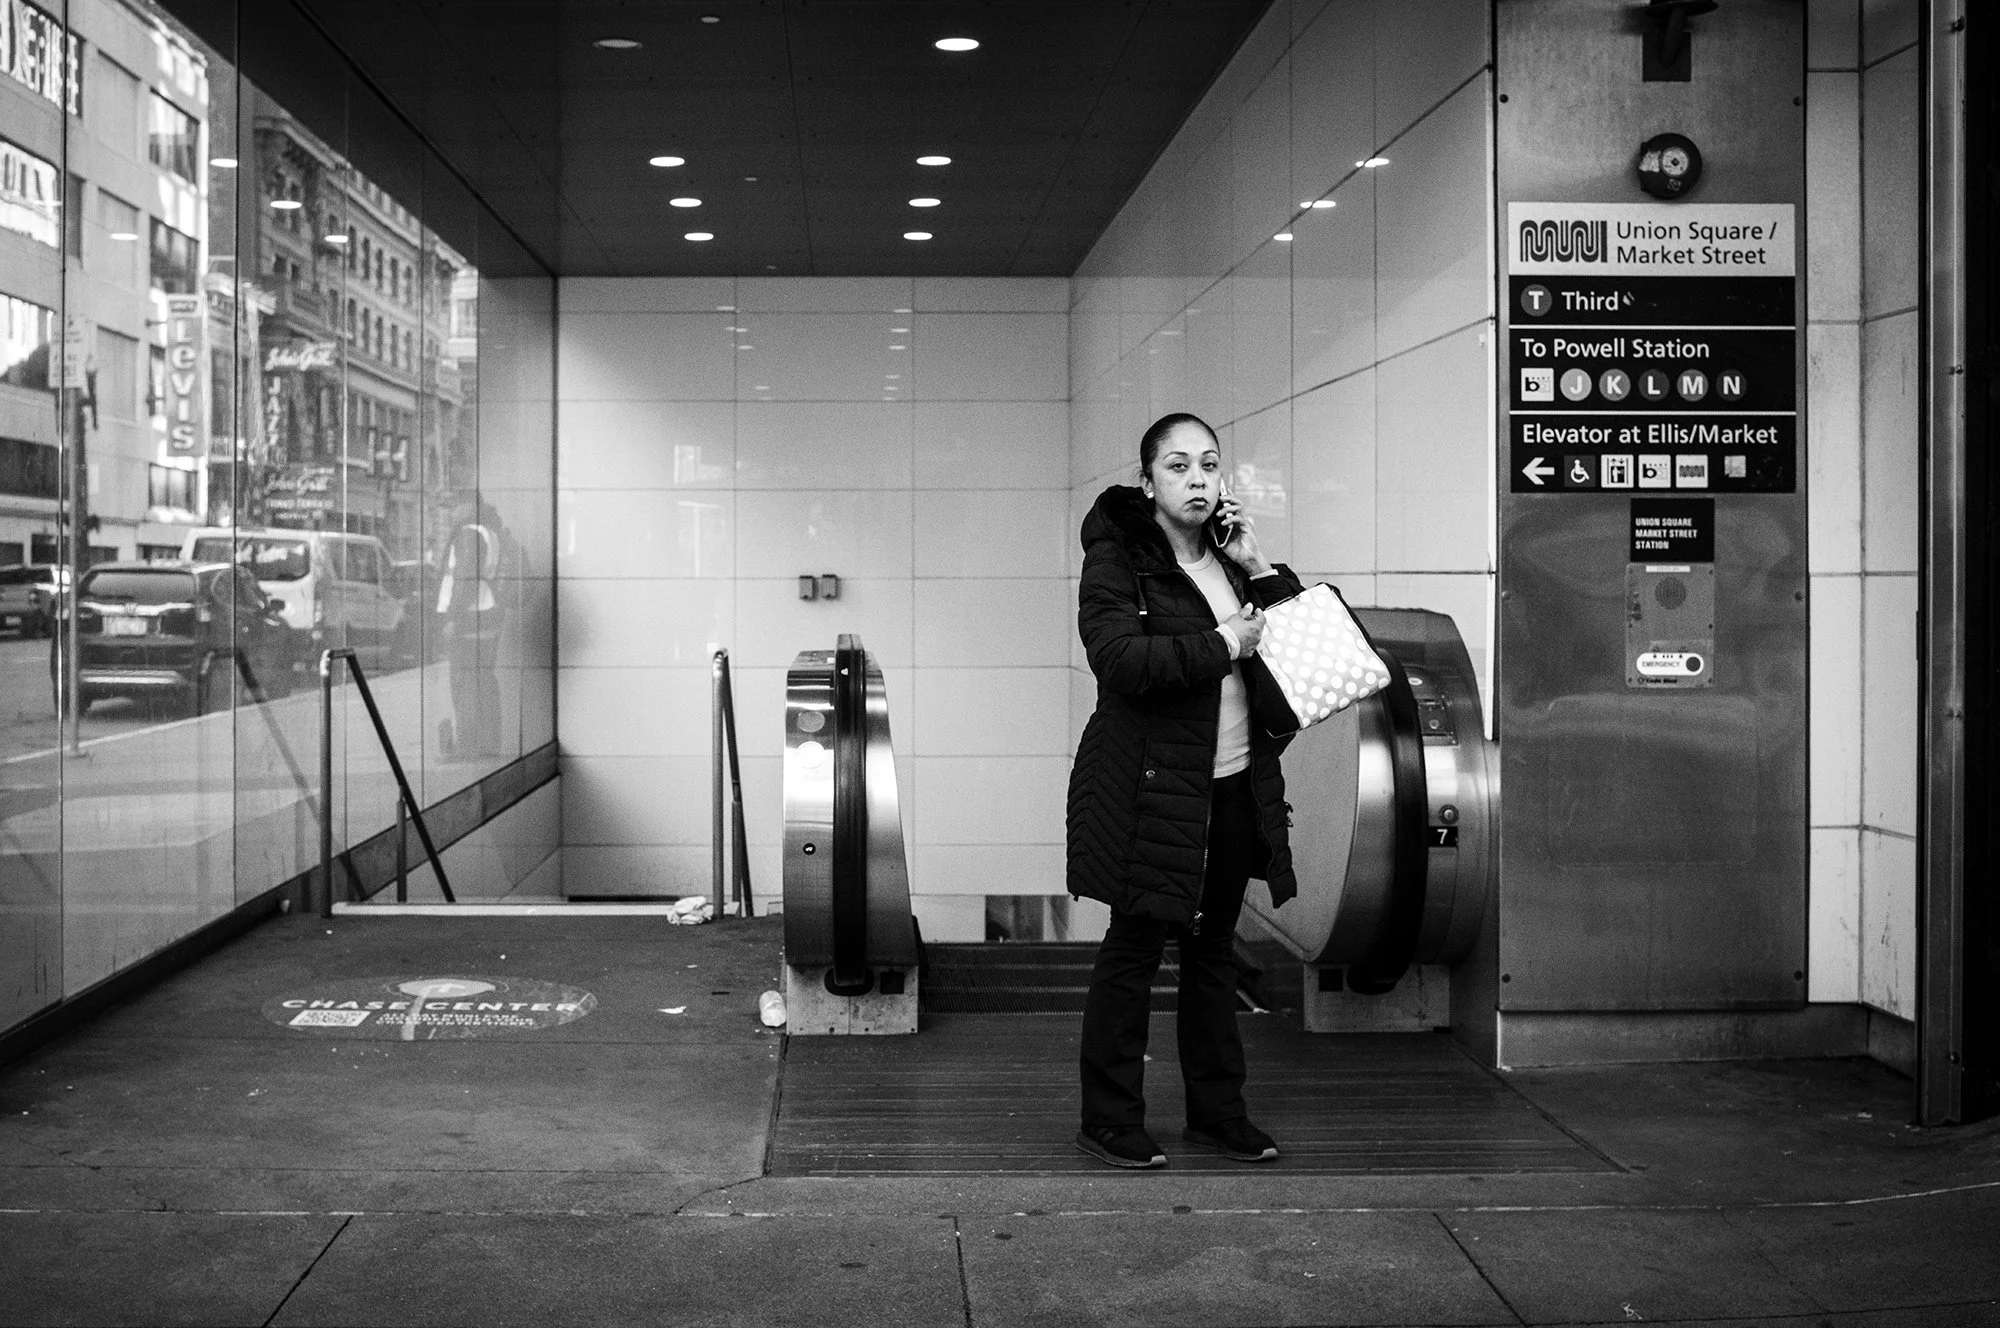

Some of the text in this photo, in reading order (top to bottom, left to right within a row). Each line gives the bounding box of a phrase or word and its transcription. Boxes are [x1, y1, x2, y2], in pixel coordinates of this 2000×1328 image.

[1617, 221, 1681, 239] Union
[1689, 221, 1763, 245] Square
[1617, 245, 1766, 264] Market Street
[1528, 291, 1544, 310] T
[1561, 291, 1619, 310] Third
[1520, 338, 1709, 358] To Powell Station
[1569, 376, 1582, 394] J
[1607, 376, 1622, 394] K
[1647, 376, 1661, 394] L
[1682, 376, 1703, 395] M
[1723, 376, 1740, 395] N
[1523, 423, 1777, 444] Elevator at Ellis/Market
[1635, 517, 1692, 527] UNION SQUARE
[1635, 529, 1698, 538] MARKET STREET
[1635, 540, 1669, 549] STATION
[1437, 828, 1448, 844] 7
[282, 999, 578, 1012] CHASE CENTER
